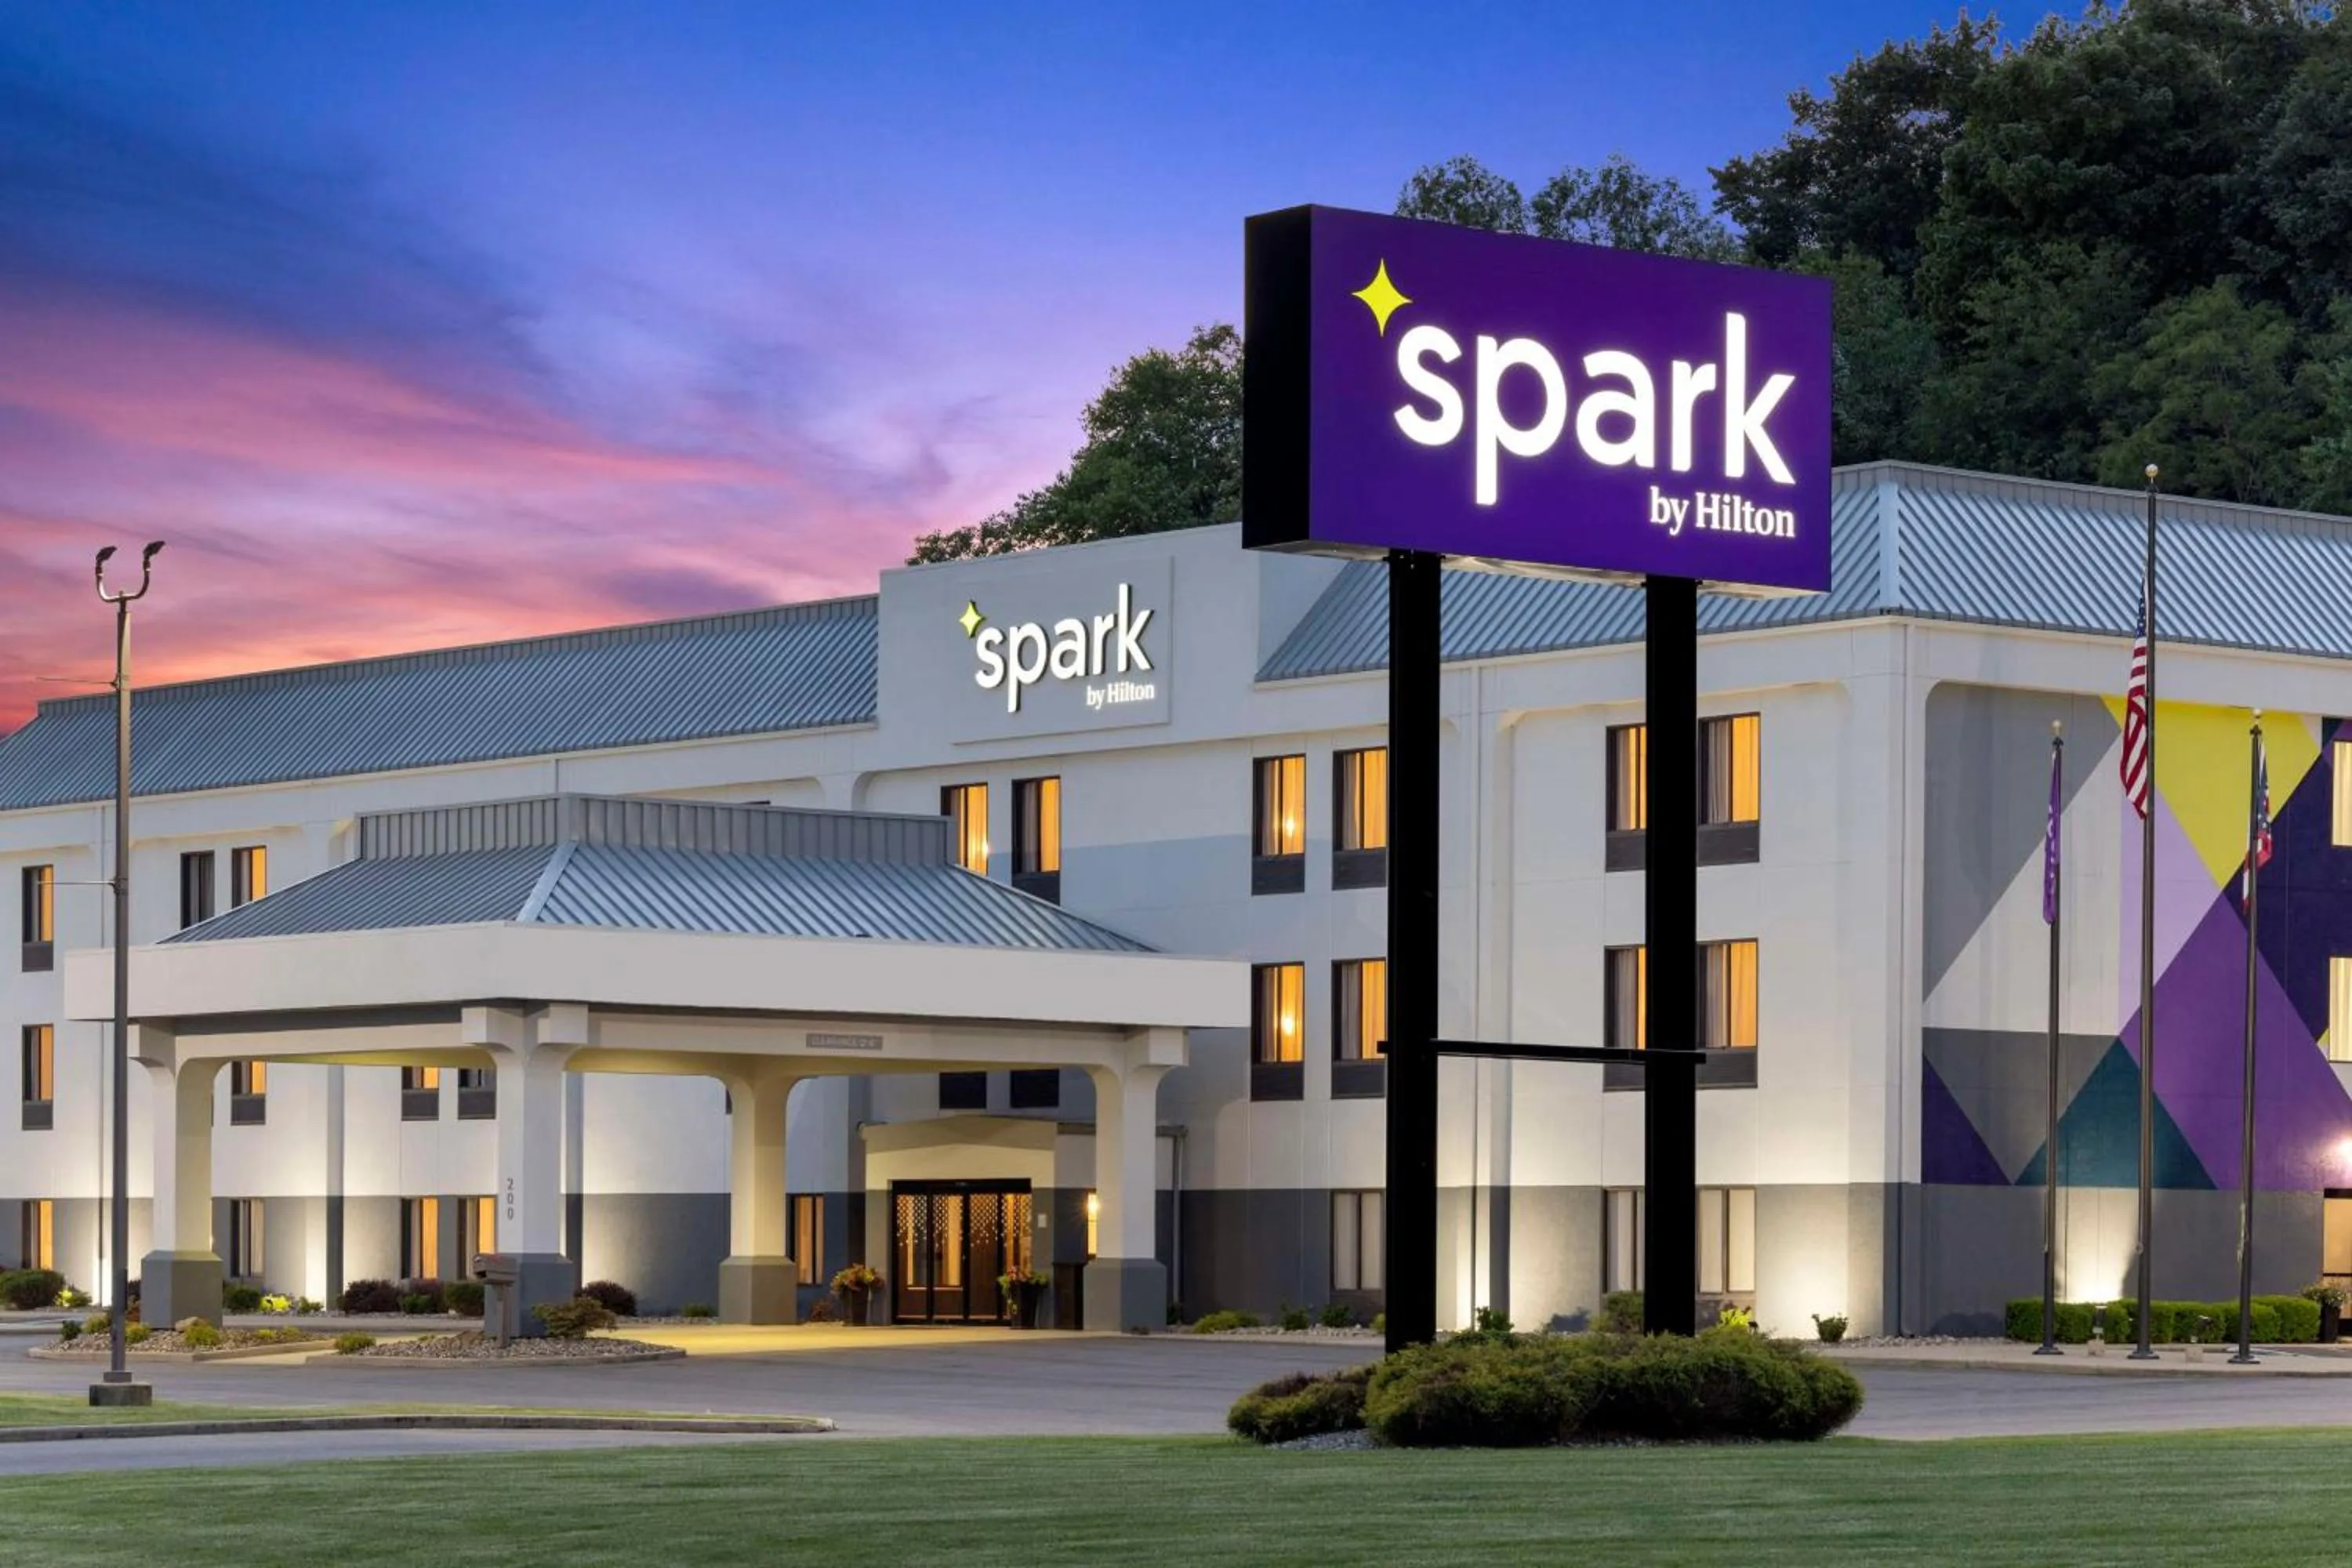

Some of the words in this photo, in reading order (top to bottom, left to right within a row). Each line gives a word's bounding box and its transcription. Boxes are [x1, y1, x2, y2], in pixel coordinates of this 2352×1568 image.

[1394, 312, 1796, 506] spark
[1650, 486, 1690, 535] by
[1696, 492, 1795, 538] Hilton
[975, 583, 1154, 713] spark
[1087, 685, 1105, 710] by
[1108, 682, 1155, 703] Hilton
